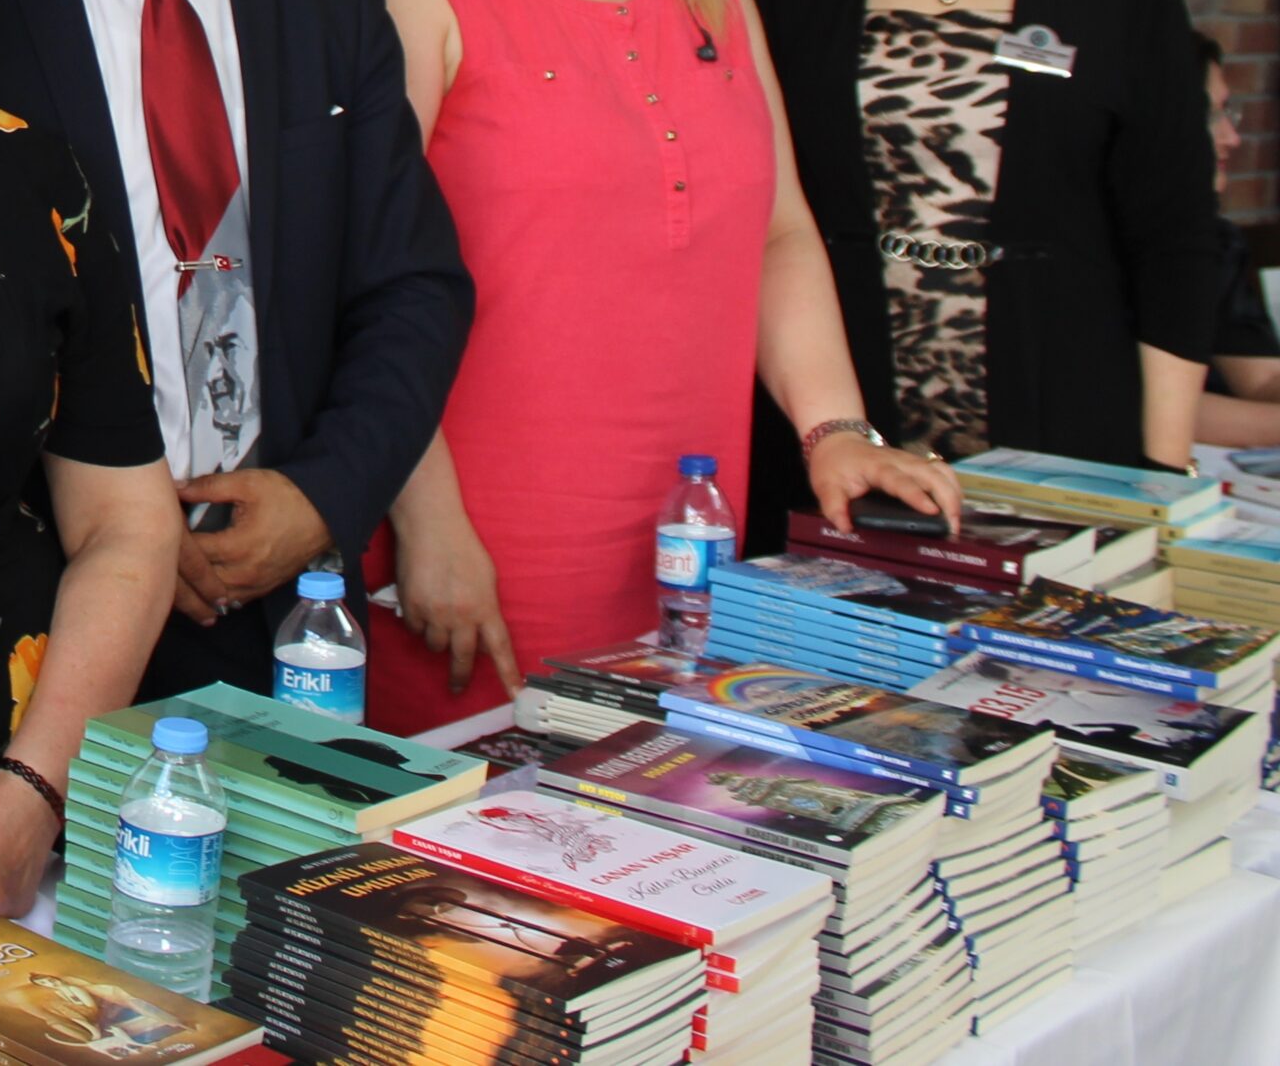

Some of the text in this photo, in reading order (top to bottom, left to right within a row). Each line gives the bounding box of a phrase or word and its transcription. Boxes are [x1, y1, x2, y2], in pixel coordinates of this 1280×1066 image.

[282, 667, 332, 692] Erikli
[116, 817, 151, 858] rikli
[285, 866, 365, 897] HÜZNÜ
[358, 854, 426, 874] KIRAN
[339, 867, 438, 898] UMUTLAR
[589, 842, 699, 886] CANAN YAŞAR
